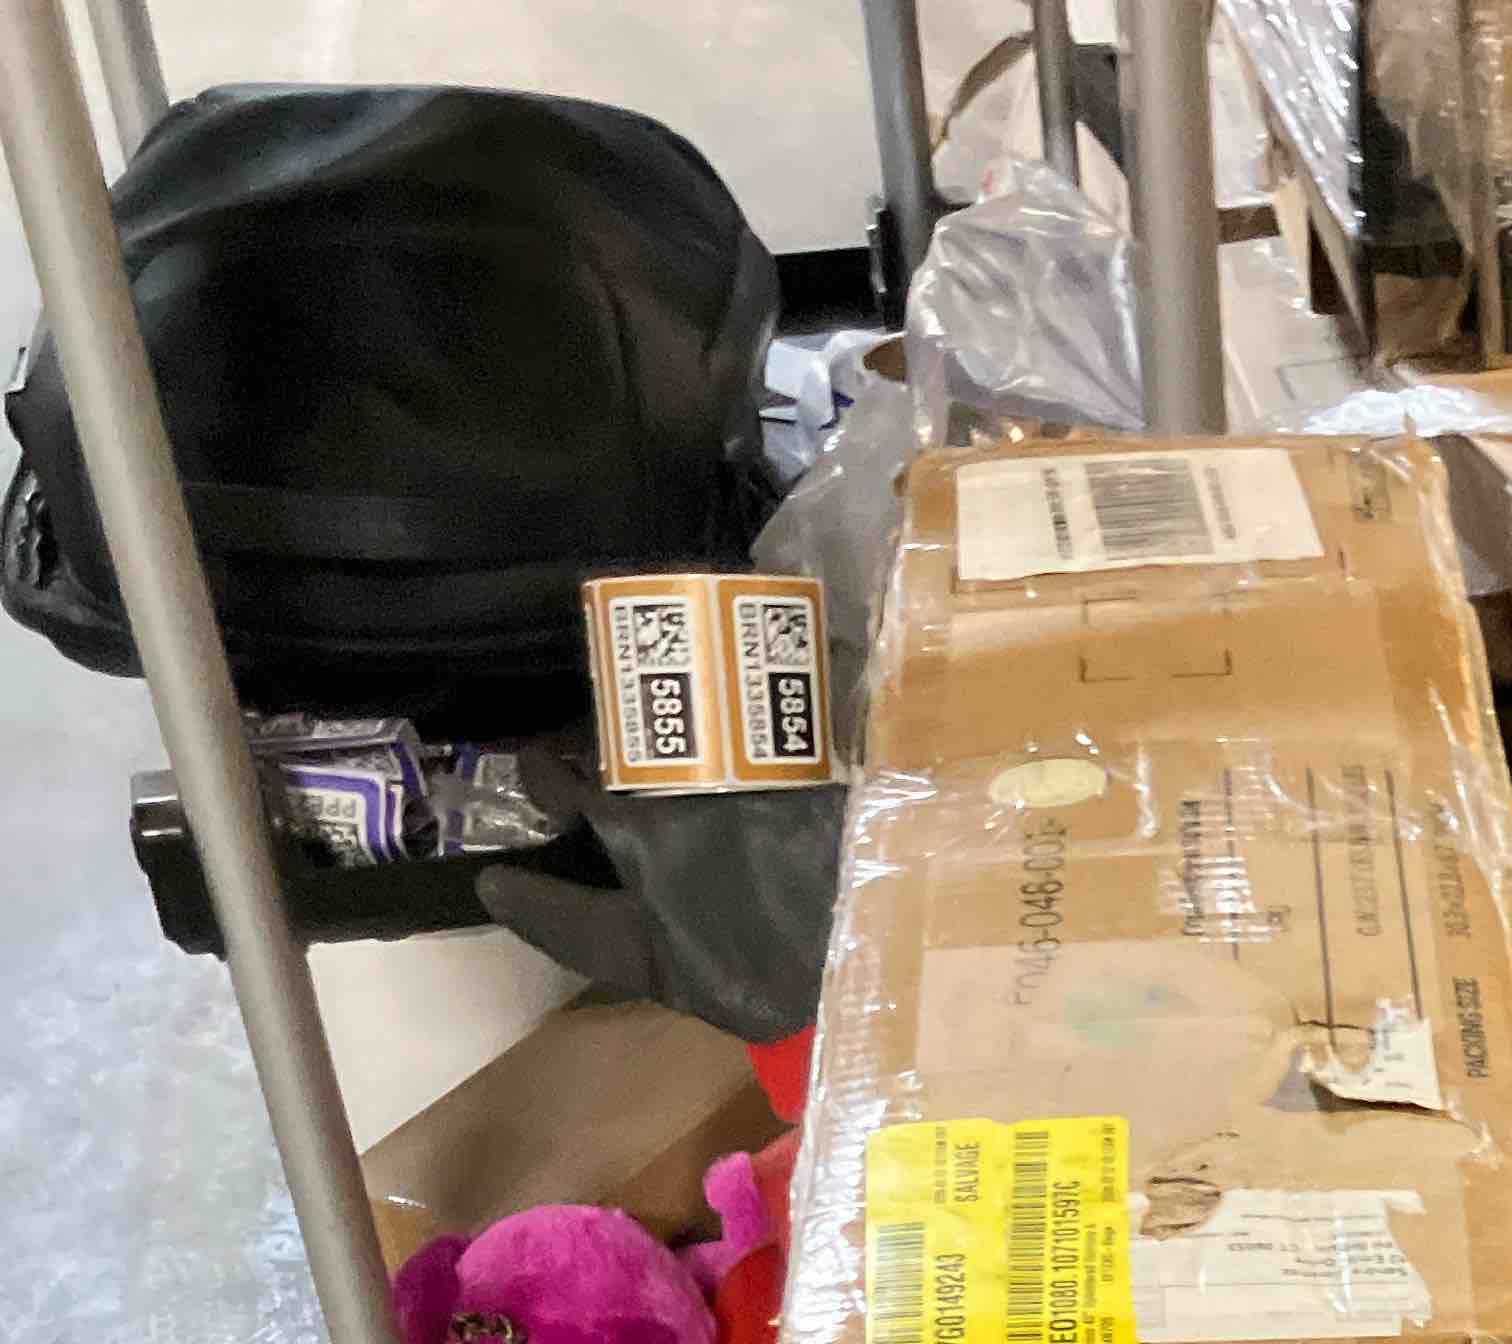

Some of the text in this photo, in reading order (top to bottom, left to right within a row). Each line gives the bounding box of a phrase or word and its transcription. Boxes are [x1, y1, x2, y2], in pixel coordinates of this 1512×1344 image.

[651, 678, 687, 754] 5855
[779, 678, 809, 753] 5854
[1457, 1011, 1489, 1079] PACKING
[951, 1140, 981, 1203] SALVAGE
